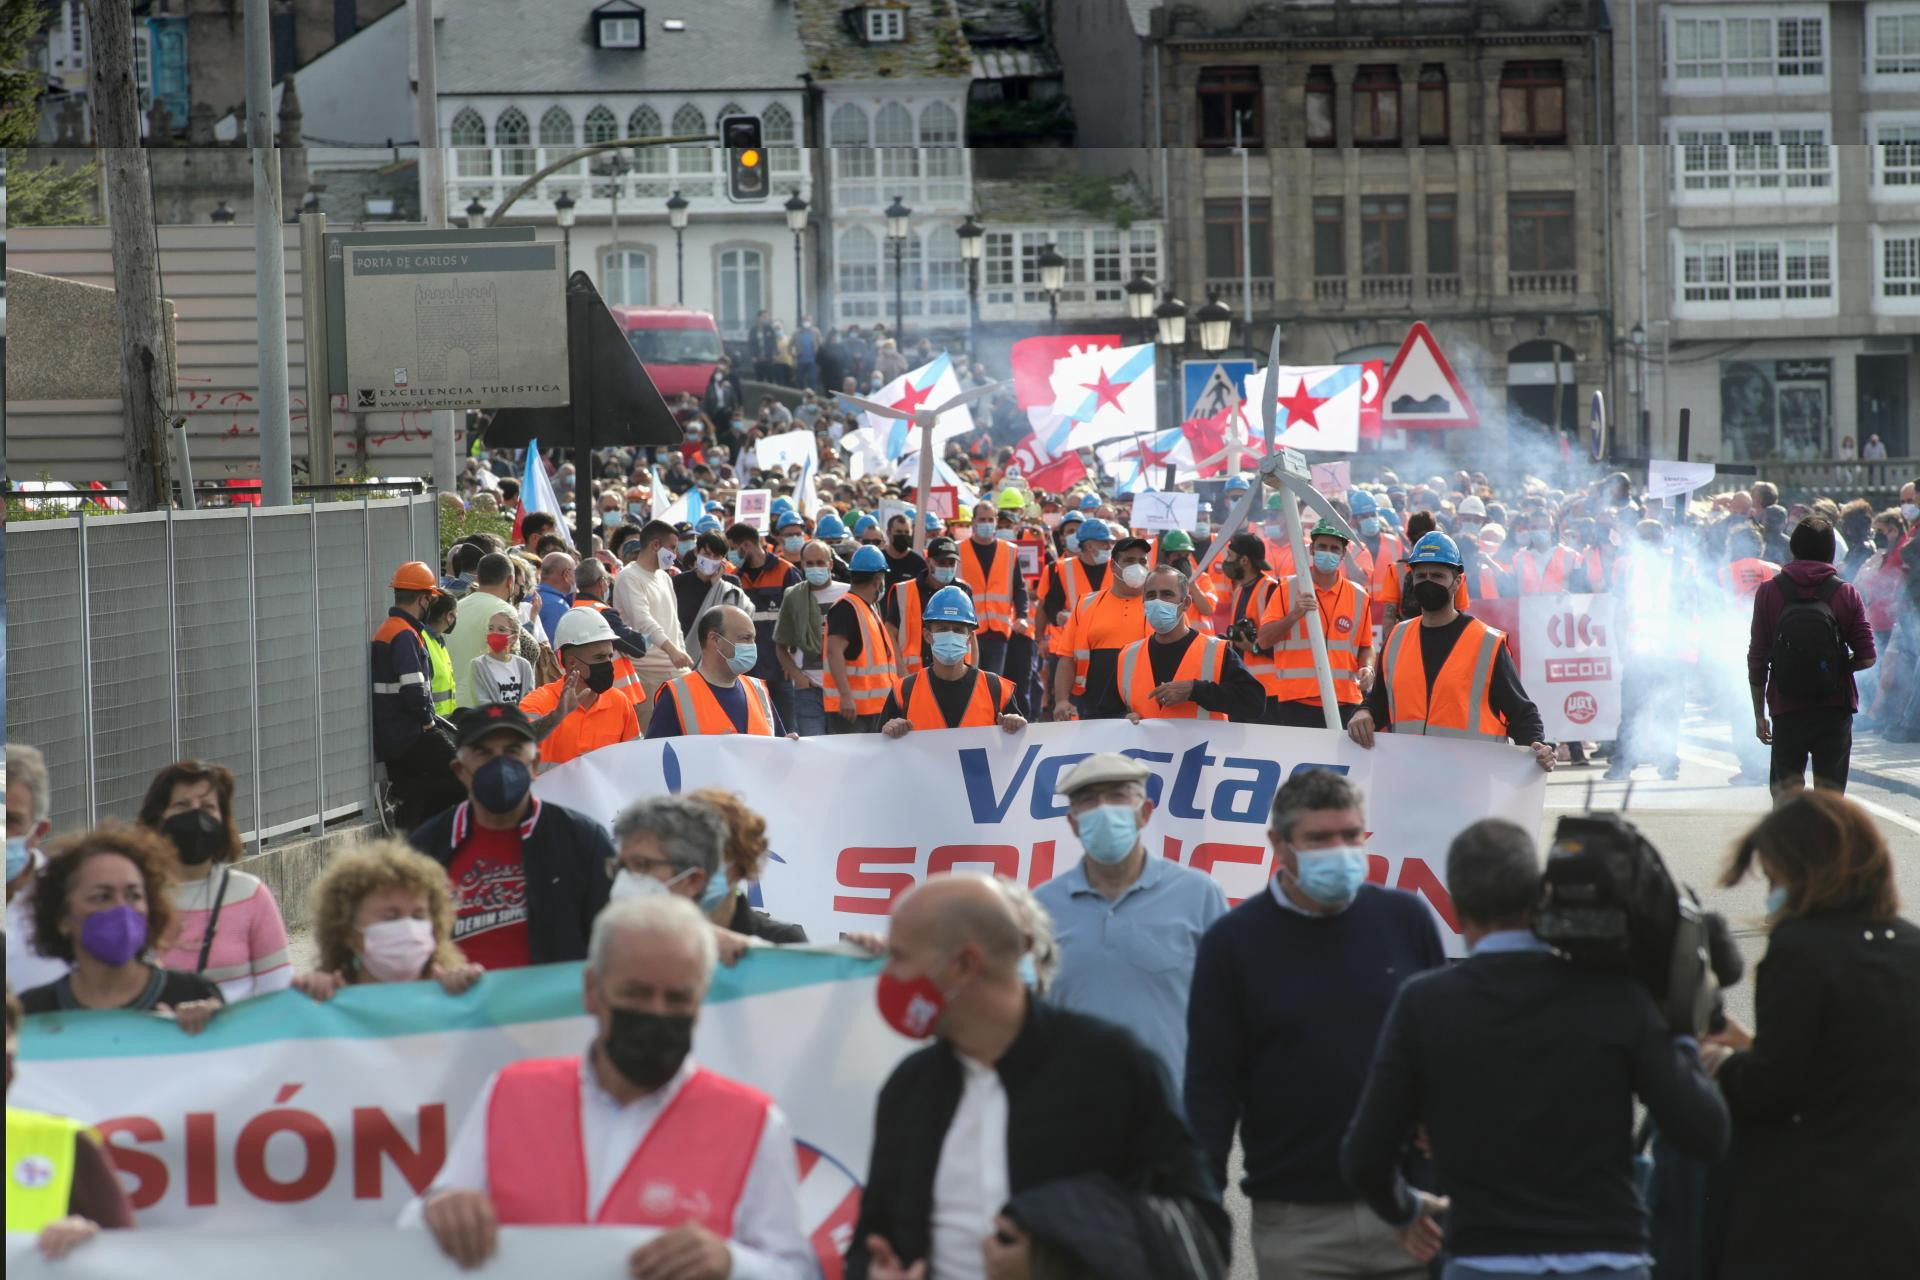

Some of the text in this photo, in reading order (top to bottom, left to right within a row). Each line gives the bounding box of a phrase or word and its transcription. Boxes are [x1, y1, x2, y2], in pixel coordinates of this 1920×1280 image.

[357, 255, 469, 269] PORTA DE CARLOS V
[379, 384, 561, 398] EXCELENCIA TURÍSTICA
[379, 399, 482, 408] www.viveiro.es
[1547, 612, 1606, 648] CIG
[1550, 662, 1608, 678] CCOO
[1567, 695, 1594, 713] UGT
[958, 741, 1350, 824] Vesta
[455, 911, 498, 937] DENIM
